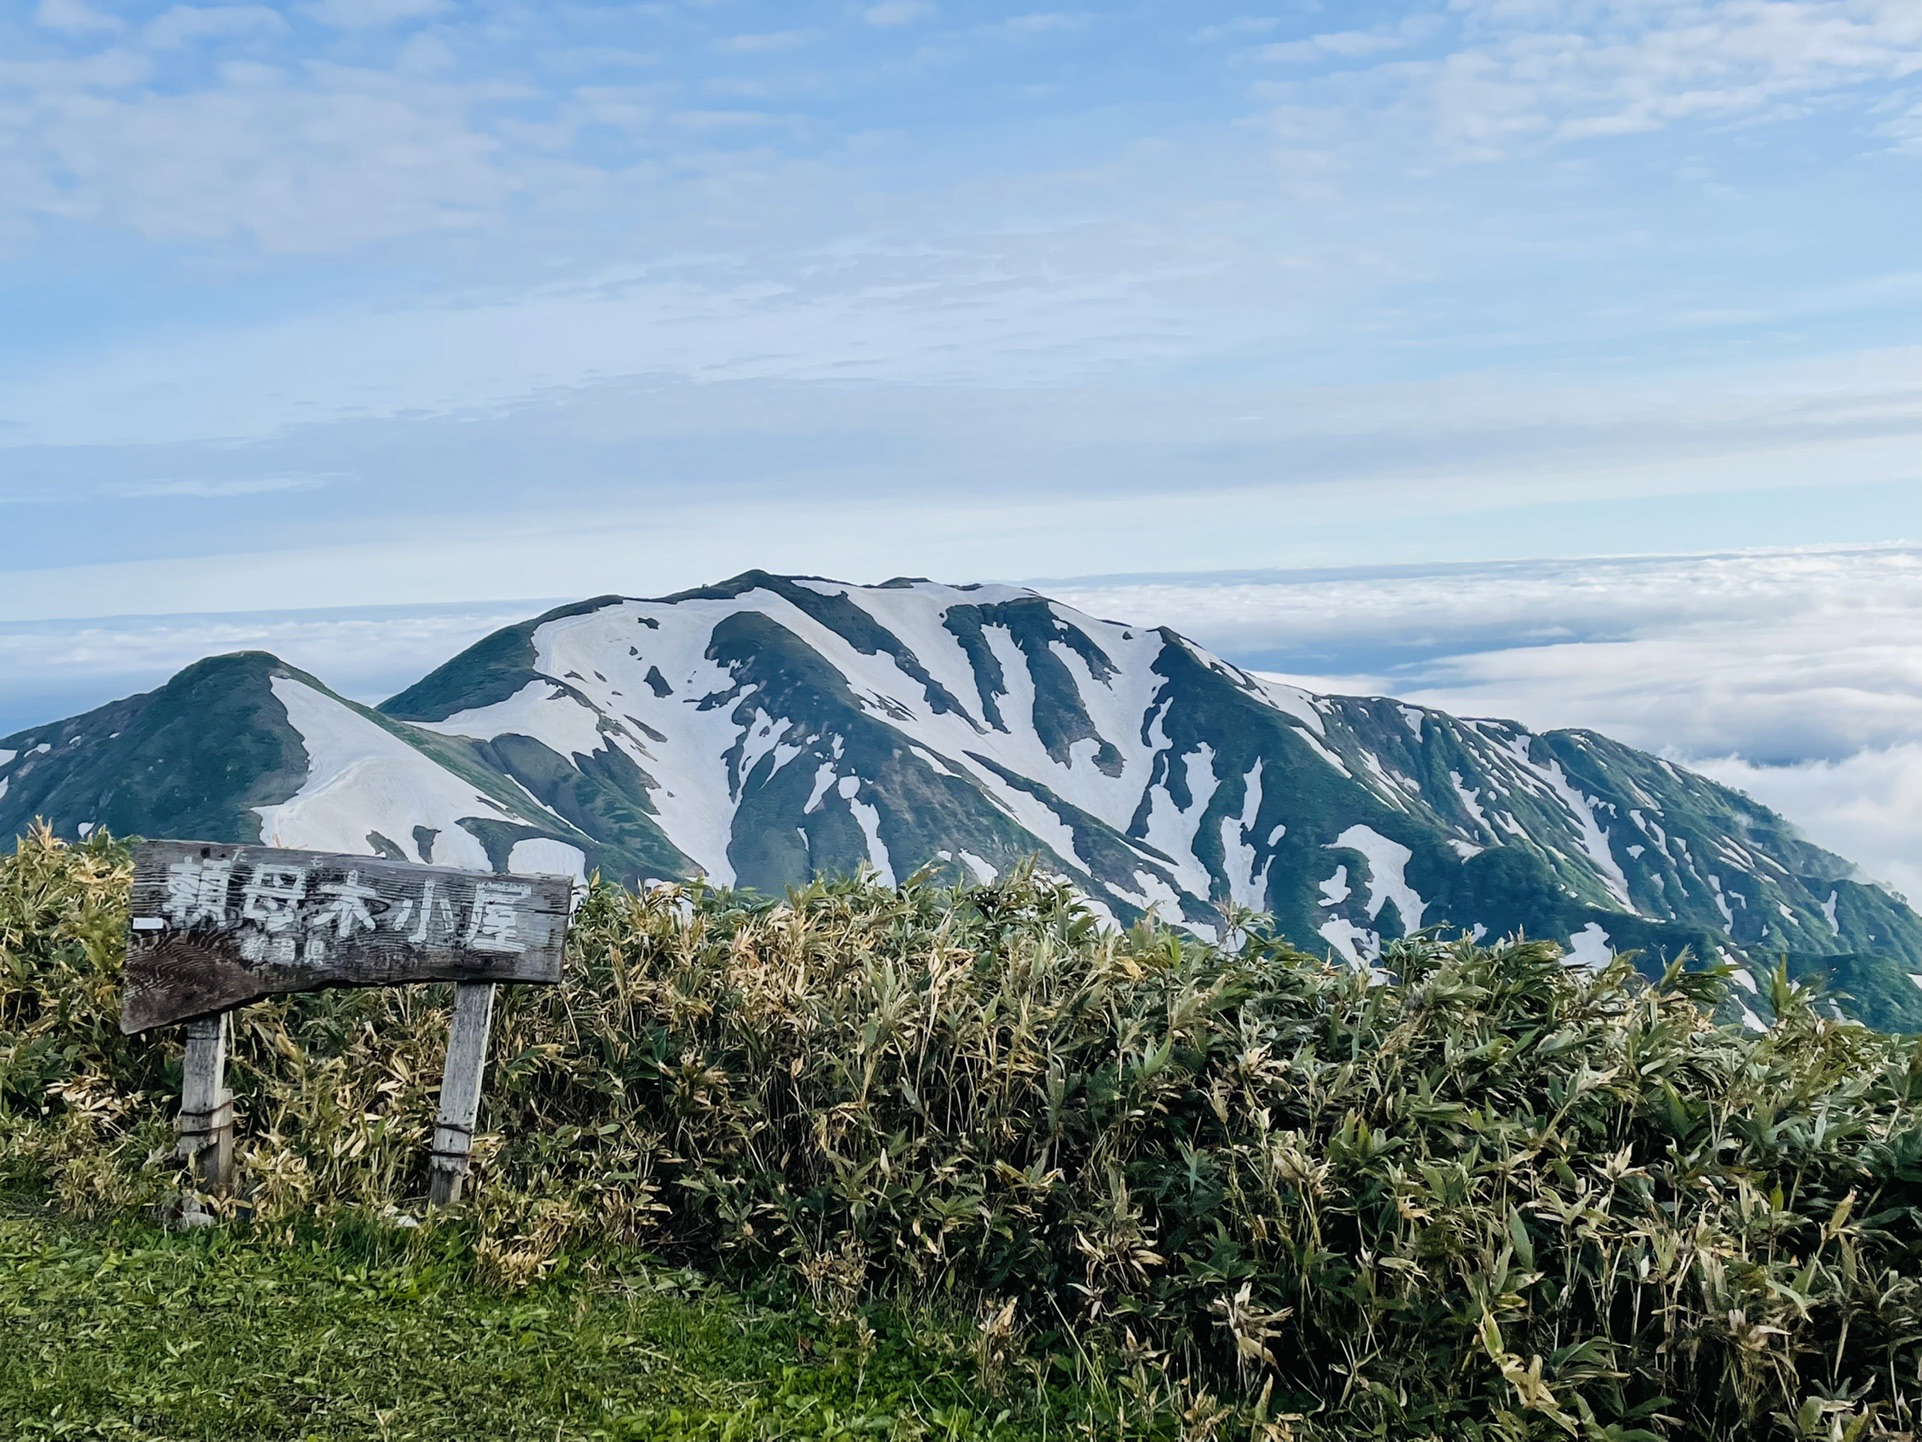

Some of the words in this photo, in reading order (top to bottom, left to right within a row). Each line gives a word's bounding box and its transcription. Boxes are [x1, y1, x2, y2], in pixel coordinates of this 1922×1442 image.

[161, 855, 532, 953] 頼母木小屋
